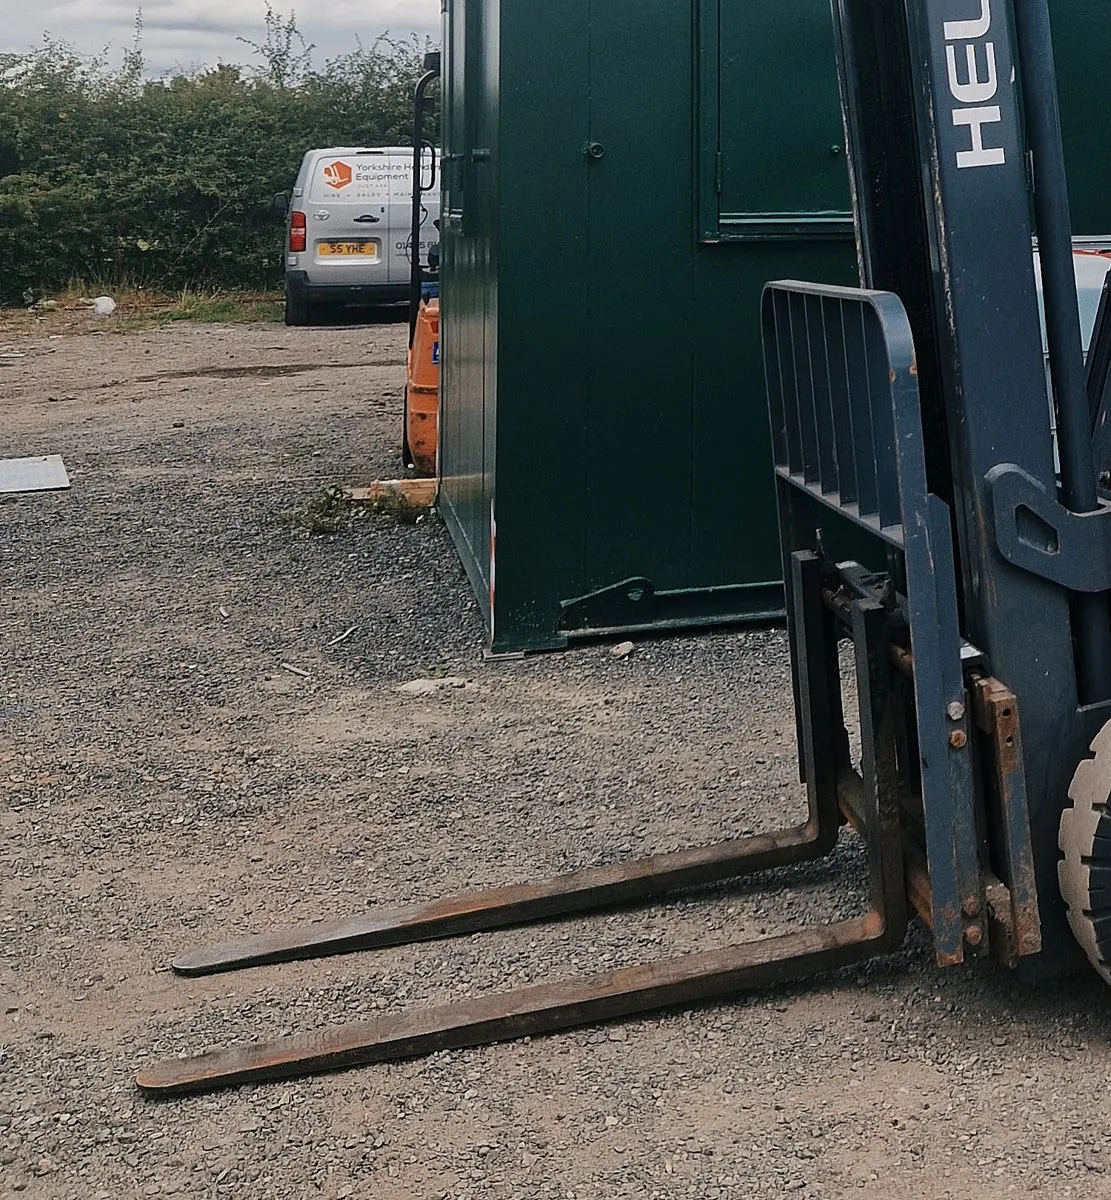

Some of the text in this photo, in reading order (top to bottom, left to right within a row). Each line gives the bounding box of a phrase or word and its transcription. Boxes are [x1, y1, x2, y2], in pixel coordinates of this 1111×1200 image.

[356, 163, 402, 171] Yorkshire
[355, 173, 409, 181] Equipment
[346, 244, 365, 253] YHE
